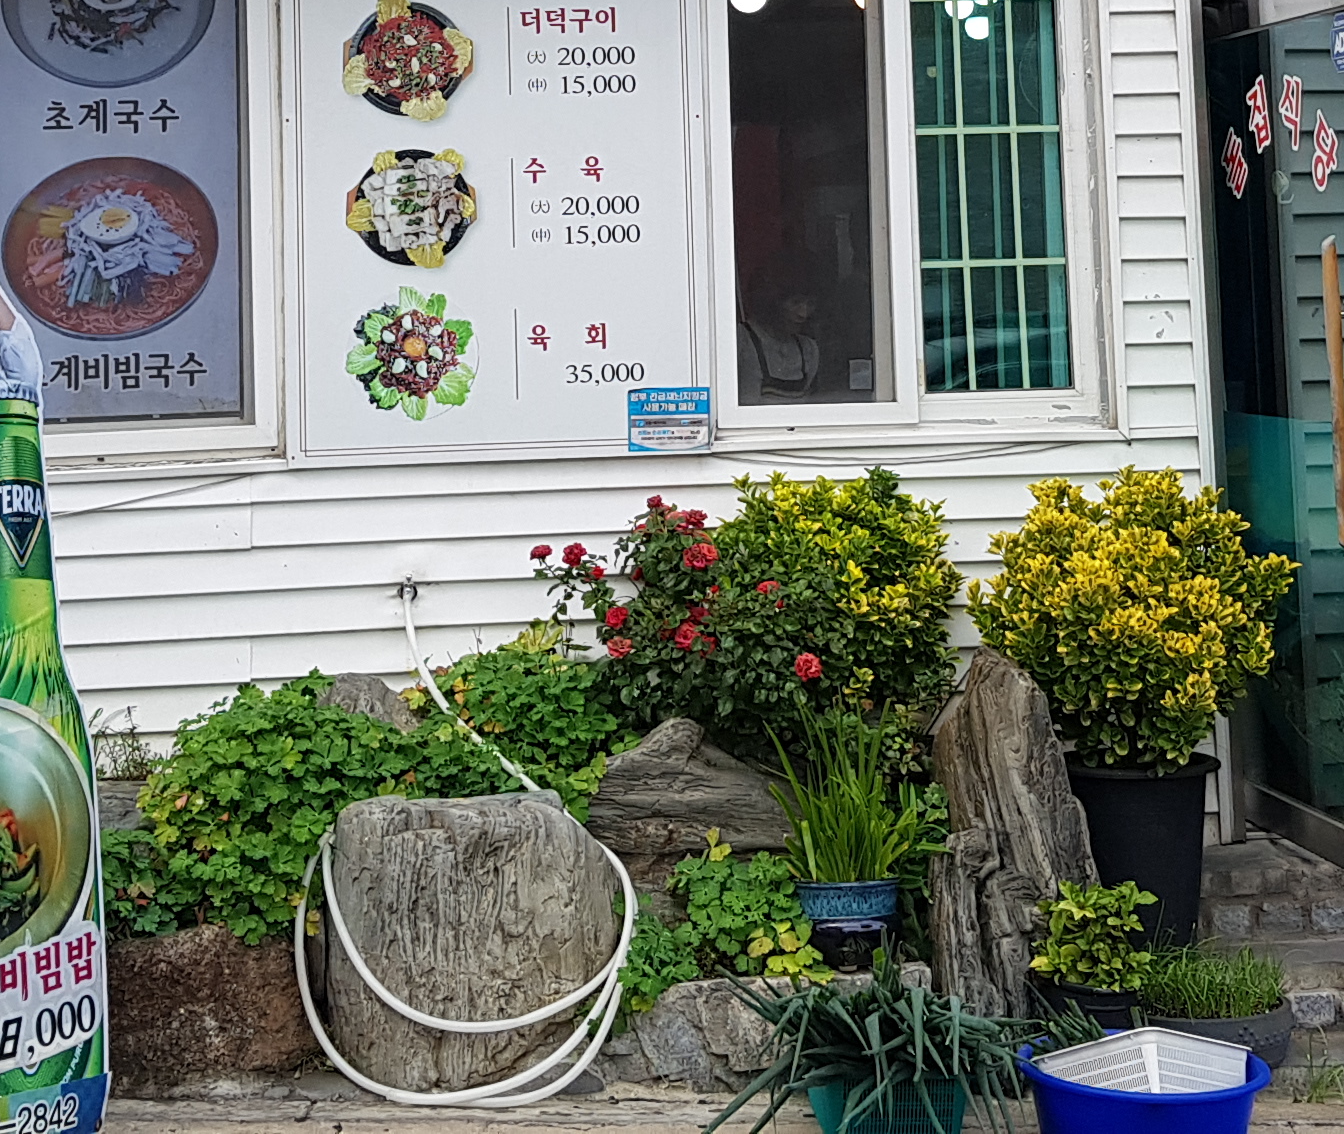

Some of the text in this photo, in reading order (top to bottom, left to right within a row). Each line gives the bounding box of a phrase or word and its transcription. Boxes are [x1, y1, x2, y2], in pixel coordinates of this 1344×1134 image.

[519, 6, 617, 35] 더덕구이
[556, 45, 636, 69] 20,000
[560, 74, 637, 98] 15,000
[41, 98, 181, 134] 초계국수
[560, 195, 641, 219] 20,000
[563, 223, 642, 248] 15,000
[42, 351, 208, 392] 계비빔국수
[564, 361, 646, 387] 35,000
